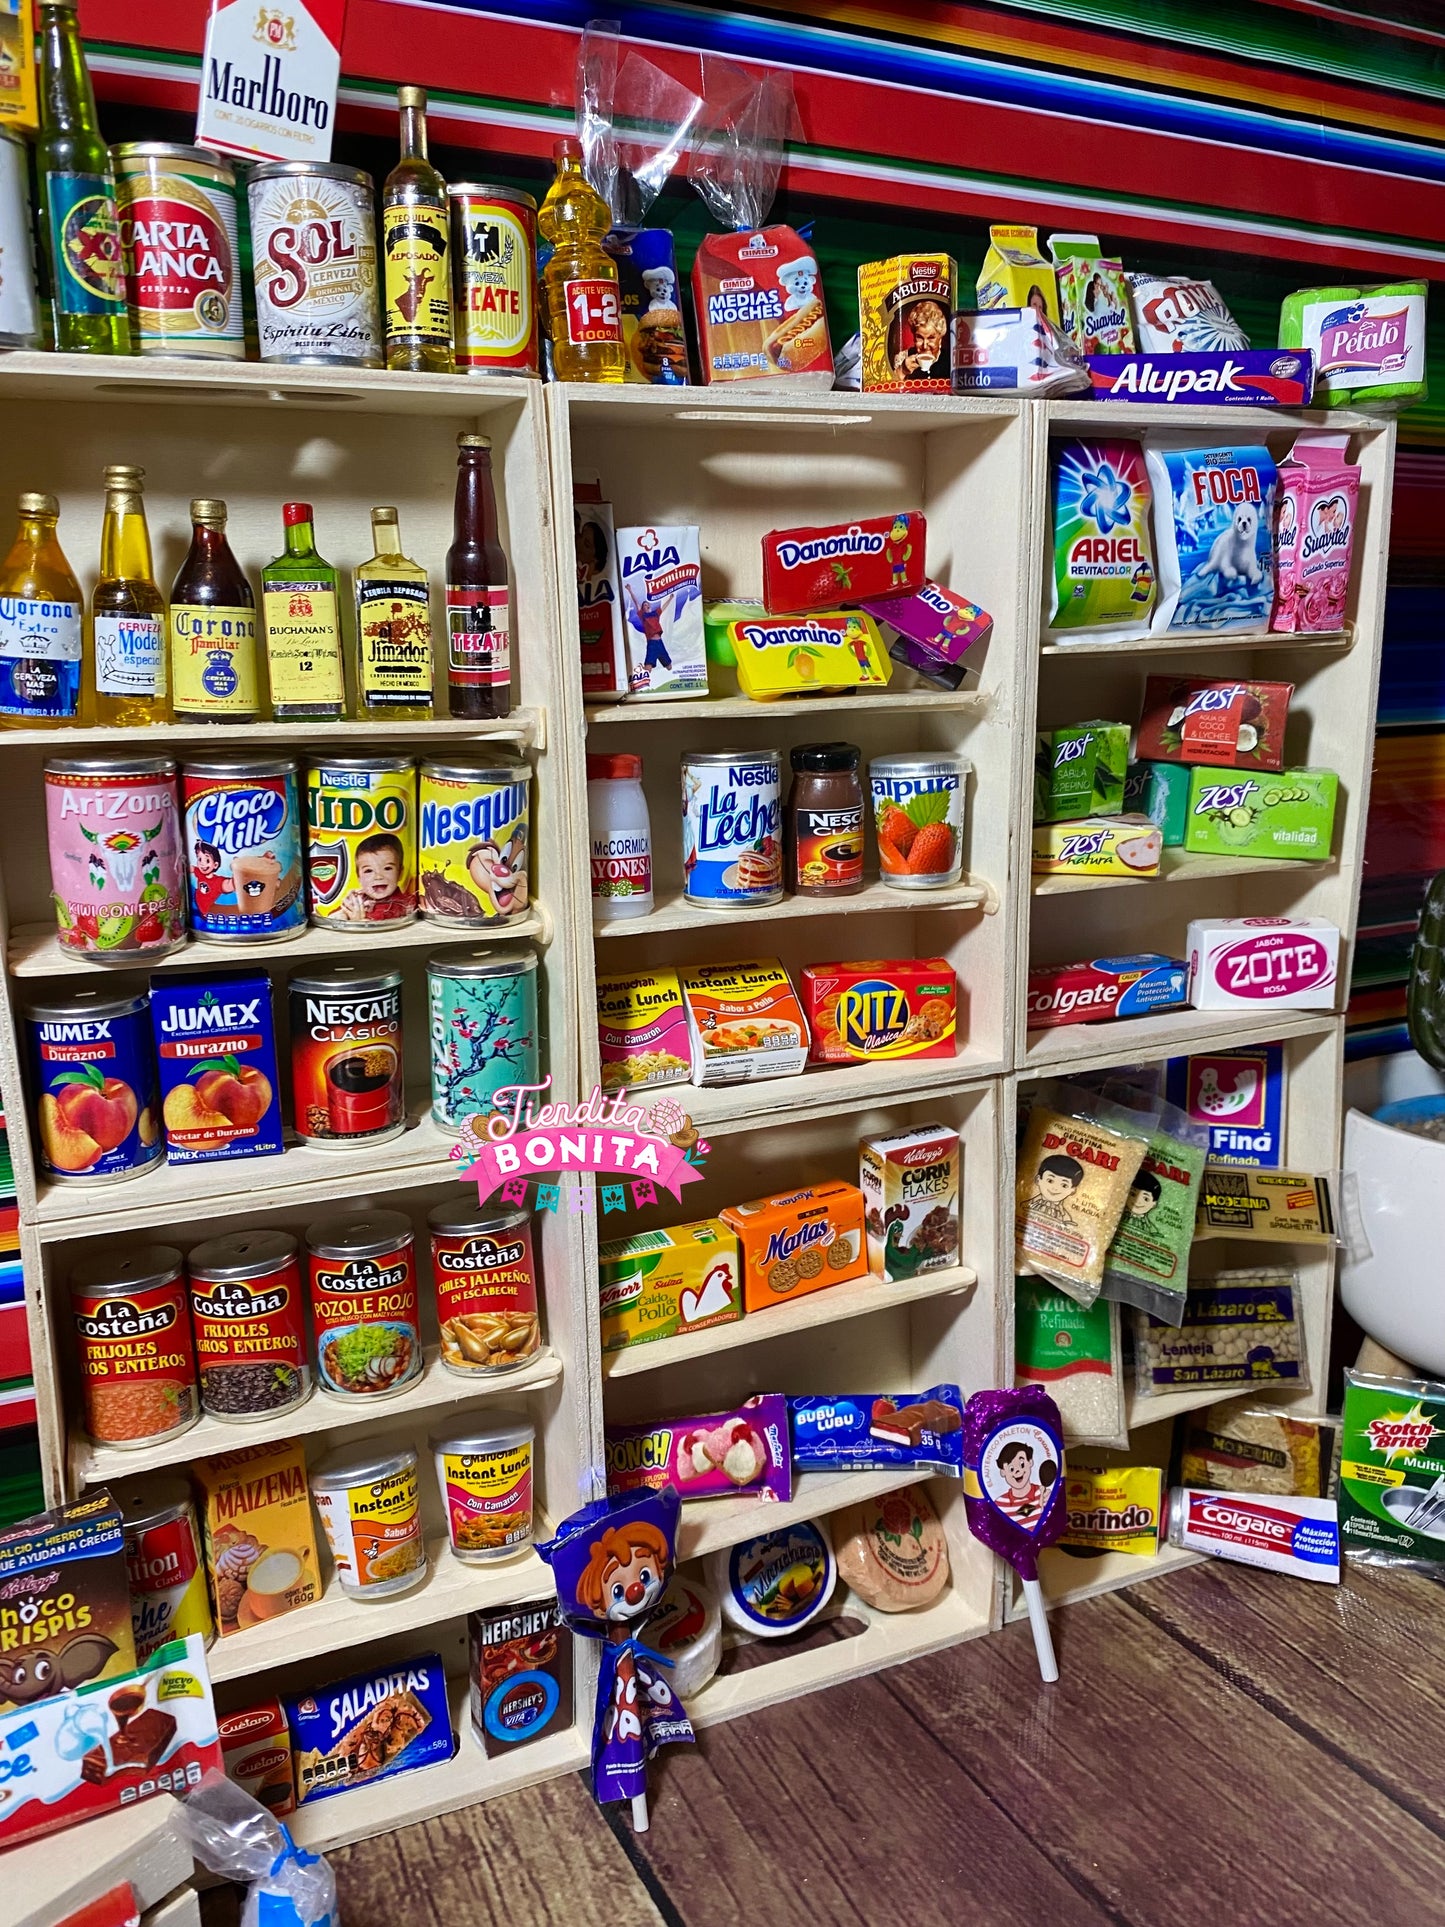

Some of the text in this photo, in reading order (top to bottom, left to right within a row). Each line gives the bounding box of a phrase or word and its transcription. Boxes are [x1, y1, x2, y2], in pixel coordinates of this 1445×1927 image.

[206, 54, 330, 130] Marlboro
[119, 219, 209, 250] CARTA
[268, 219, 355, 308] SOL
[740, 248, 777, 259] BIMBO
[121, 249, 225, 284] BLANCA
[313, 267, 357, 281] CERVEZA
[911, 266, 937, 278] Nestlé
[140, 284, 190, 294] CERVEZA
[722, 278, 754, 291] BIMBO
[891, 281, 951, 305] ABUELIT
[708, 291, 779, 312] MEDIAS
[1143, 283, 1222, 334] ROMA
[709, 305, 783, 325] NOCHES
[1085, 309, 1126, 337] Suavitel
[329, 322, 372, 341] Libre
[1331, 322, 1399, 358] Pétalo
[1111, 360, 1246, 401] Alupak
[1192, 467, 1261, 505] FOCA
[777, 530, 883, 568] Danonino
[1071, 538, 1145, 563] ARIEL
[1303, 527, 1350, 558] Suavitel
[622, 546, 680, 578] LALA
[1071, 565, 1131, 576] REVITACOLOR
[648, 567, 696, 593] Premium
[0, 597, 73, 627] Corona
[118, 621, 162, 633] CERVEZA
[176, 612, 255, 638] Corona
[269, 625, 334, 635] BUCHANAN'S
[190, 636, 240, 657] Familiar
[451, 631, 509, 653] TECATE
[745, 625, 843, 649] Danonino
[299, 661, 313, 671] 12
[1198, 730, 1231, 741] LYCHEE
[1199, 722, 1226, 731] COCO
[322, 772, 367, 786] Nestlé
[728, 765, 779, 787] Nestlé
[60, 789, 173, 820] AriZona
[198, 790, 276, 827] Choco
[308, 786, 406, 830] NIDO
[712, 784, 737, 815] La
[212, 815, 281, 853] Milk
[1272, 831, 1317, 844] vitalidad
[593, 836, 649, 856] McCORMICK
[591, 857, 652, 879] AYONESA
[1067, 852, 1114, 866] natura
[67, 898, 182, 918] KIWI CON FRES
[1254, 936, 1284, 949] JABÓN
[1227, 944, 1318, 989] ZOTE
[684, 969, 784, 990] Instant Lunch
[1139, 980, 1167, 990] Máxima
[636, 989, 678, 1006] Lunch
[1027, 983, 1119, 1013] Colgate
[1263, 985, 1288, 995] ROSA
[306, 992, 399, 1025] NESCAFÉ
[719, 1002, 745, 1012] Sabor
[753, 996, 774, 1010] Pollo
[161, 998, 261, 1033] JUMEX
[839, 989, 906, 1042] RITZ
[40, 1020, 112, 1042] JUMEX
[310, 1021, 398, 1043] CLÁSICO
[605, 1026, 661, 1044] Con Camarón
[49, 1049, 106, 1062] Durazno
[175, 1038, 249, 1057] Durazno
[171, 1126, 255, 1142] Néctar de Durazno
[1063, 1132, 1103, 1149] GELATINA
[166, 1150, 199, 1161] JUMEX
[903, 1146, 944, 1165] Kellogg's
[1208, 1153, 1260, 1166] Refinada
[901, 1162, 951, 1187] CORN
[902, 1177, 950, 1200] FLAKES
[442, 1246, 520, 1269] Costeña
[471, 1242, 491, 1254] La
[352, 1262, 373, 1276] La
[321, 1269, 403, 1291] Costeña
[438, 1270, 531, 1296] CHILES JALAPEÑOS
[653, 1277, 684, 1290] Suiza
[219, 1286, 244, 1300] La
[451, 1285, 518, 1304] EN ESCABECHE
[599, 1280, 642, 1306] Knorr
[638, 1292, 677, 1307] Caldo de
[105, 1301, 131, 1319] La
[193, 1294, 281, 1316] Costeña
[315, 1292, 414, 1318] POZOLE ROJO
[638, 1303, 677, 1323] Pollo
[76, 1310, 170, 1336] Costeña
[203, 1323, 269, 1338] FRIJOLES
[678, 1312, 737, 1333] SIN CONSERVADORES
[1040, 1314, 1085, 1330] Refinada
[87, 1341, 157, 1360] FRIJOLES
[234, 1335, 298, 1354] ENTEROS
[1162, 1342, 1213, 1357] Lenteja
[115, 1353, 186, 1375] ENTEROS
[1173, 1366, 1246, 1381] San Lázaro
[797, 1406, 836, 1425] BUBU
[817, 1414, 854, 1431] LUBU
[999, 1426, 1031, 1442] PALETON
[1368, 1420, 1437, 1437] Scotch-
[920, 1435, 934, 1446] 35
[1375, 1434, 1428, 1450] Brite
[447, 1455, 530, 1480] Instant Lunch
[215, 1465, 305, 1523] MAIZENA
[354, 1490, 405, 1515] Instant
[466, 1490, 519, 1510] Con Camarón
[1202, 1506, 1286, 1538] Colgate
[1342, 1520, 1351, 1534] 4
[1350, 1515, 1377, 1526] Contenido
[0, 1518, 120, 1561] ALCIO HIERRO ZINC
[384, 1527, 408, 1539] Sabor
[1294, 1533, 1337, 1548] Protección
[1301, 1526, 1334, 1538] Máxima
[0, 1528, 122, 1573] UE AYUDAN A CRECER
[1293, 1541, 1334, 1556] Anticaries
[0, 1571, 61, 1600] Kellogg's
[155, 1571, 183, 1589] Clavel
[287, 1591, 315, 1608] 160g
[0, 1605, 93, 1652] RISPIS
[162, 1677, 194, 1688] Nuevo
[330, 1667, 430, 1738] SALADITAS
[502, 1691, 544, 1715] HERSHEY'S
[219, 1714, 273, 1735] Cuétara
[432, 1738, 448, 1750] 58g
[235, 1751, 289, 1776] Cuétara
